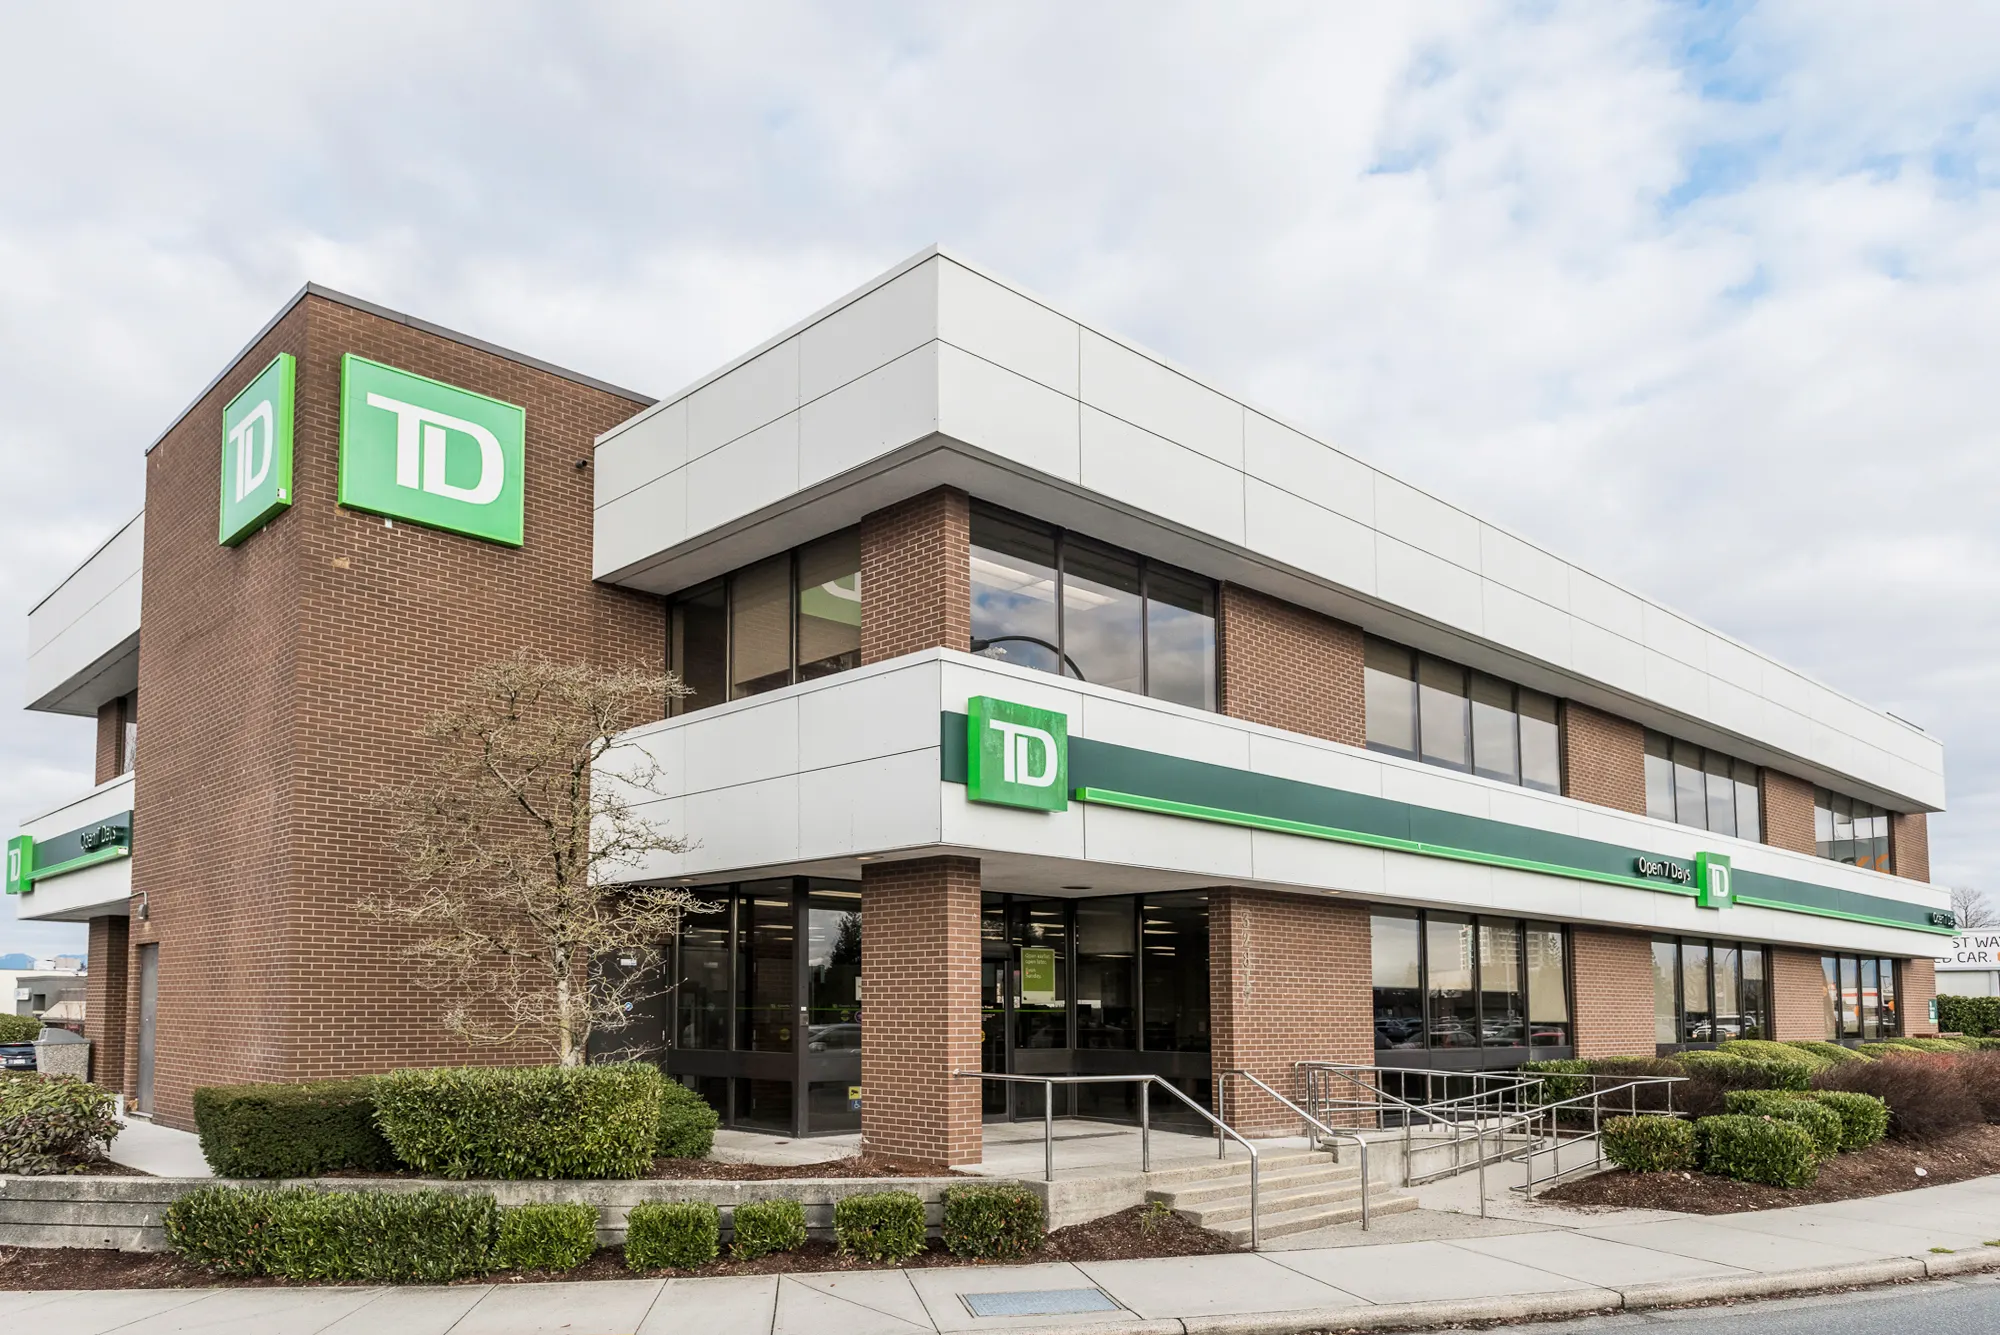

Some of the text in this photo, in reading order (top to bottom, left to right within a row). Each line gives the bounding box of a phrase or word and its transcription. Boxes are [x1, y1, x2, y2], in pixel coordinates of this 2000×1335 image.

[229, 399, 274, 504] TD
[367, 392, 505, 505] TD
[989, 718, 1059, 788] TD
[9, 848, 20, 882] TD
[1639, 856, 1691, 884] Open 7 Days
[1707, 862, 1730, 898] TD
[1956, 951, 1992, 963] CAR.
[1974, 935, 2000, 948] WA
